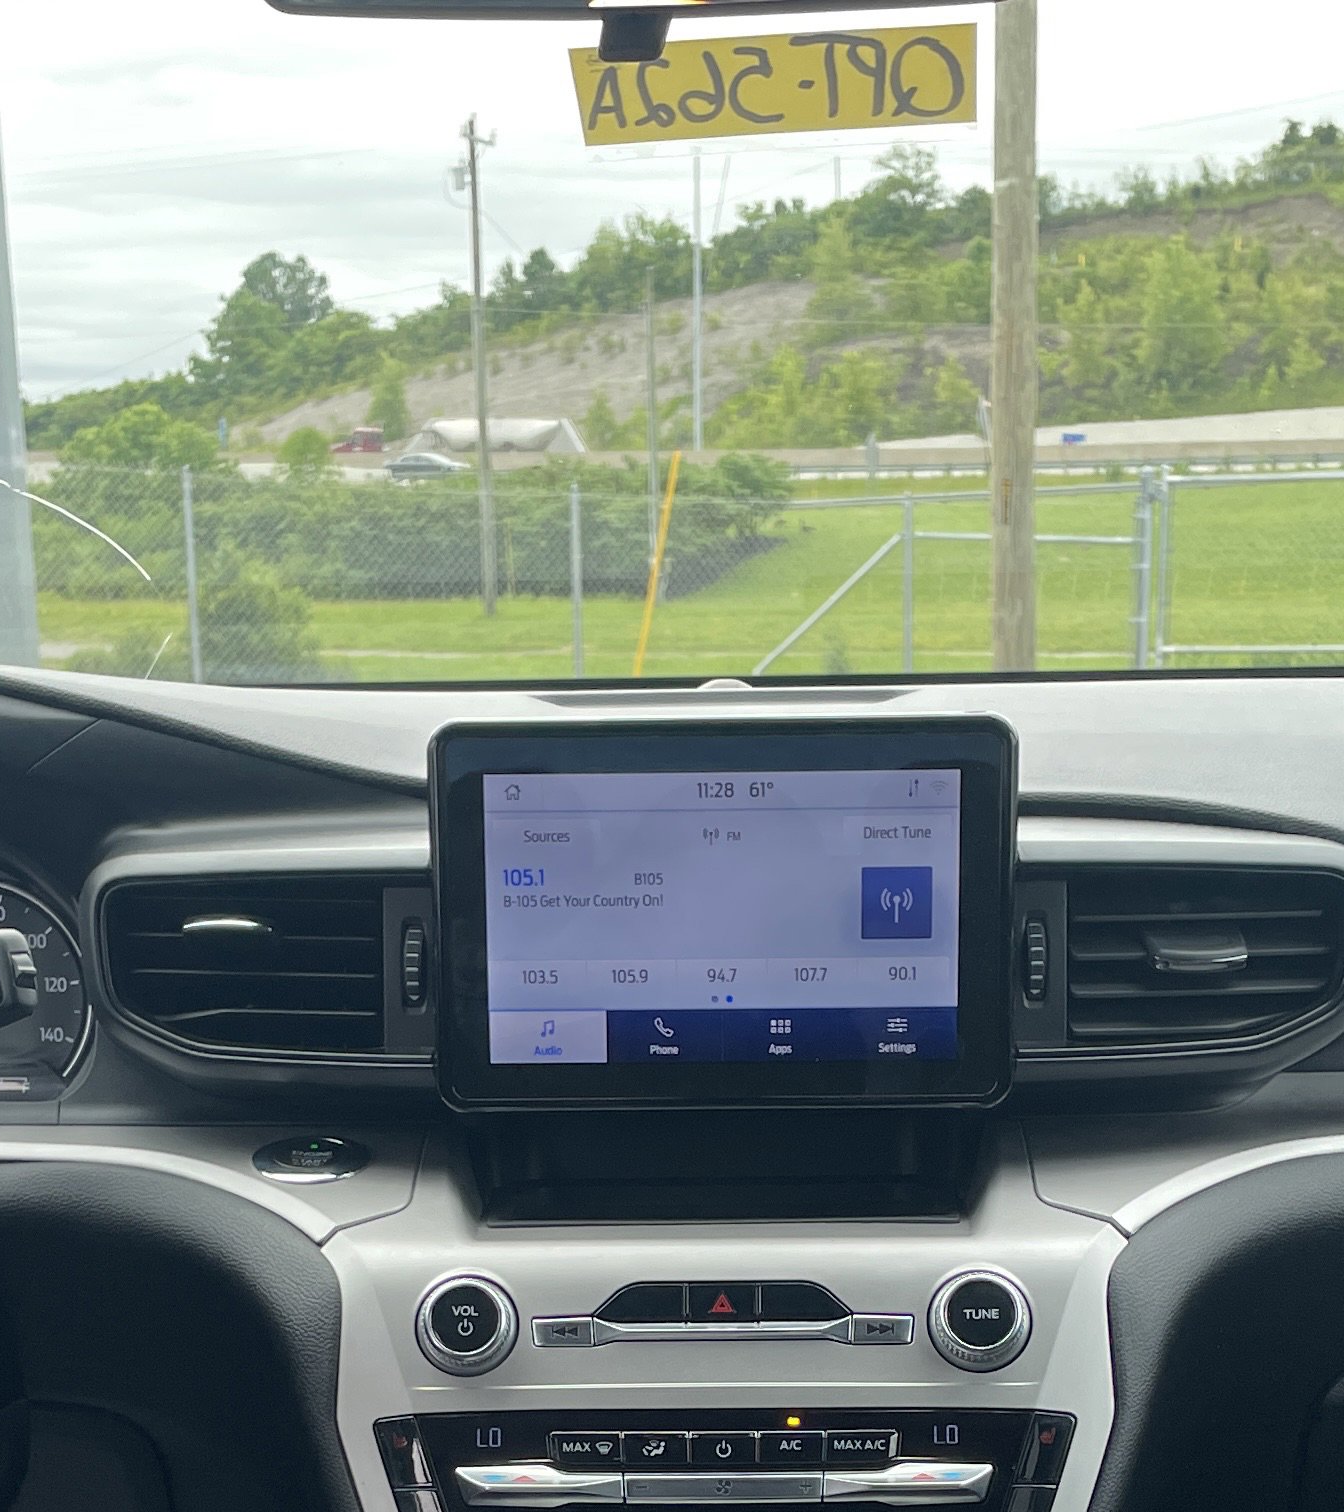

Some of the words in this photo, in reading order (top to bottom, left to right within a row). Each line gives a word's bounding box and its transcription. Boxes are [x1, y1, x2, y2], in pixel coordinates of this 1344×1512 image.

[697, 781, 734, 799] 11:28
[749, 781, 773, 799] 61°
[524, 830, 570, 844] Sources
[727, 831, 741, 841] FM
[864, 827, 898, 839] Direct
[902, 826, 931, 838] Tune
[503, 869, 545, 887] 105.1
[634, 872, 664, 886] B105
[503, 894, 537, 907] B-105
[540, 895, 560, 908] Get
[563, 895, 590, 908] Your
[593, 895, 641, 910] Country
[643, 894, 664, 907] On!
[26, 934, 47, 949] 00
[522, 969, 558, 985] 103.5
[612, 969, 649, 985] 105.9
[707, 968, 737, 984] 94.7
[794, 967, 827, 982] 107.7
[889, 966, 917, 981] 90.1
[44, 978, 66, 992] 120
[40, 1028, 63, 1042] 140
[534, 1045, 562, 1057] Audio
[650, 1044, 679, 1056] Phone
[769, 1043, 792, 1057] Apps
[878, 1042, 916, 1055] Settings
[451, 1305, 479, 1318] VOL
[963, 1307, 1000, 1320] TUNE
[562, 1442, 591, 1454] MAX
[779, 1440, 802, 1452] A/C
[833, 1440, 861, 1451] MAX
[863, 1440, 887, 1452] A/C
